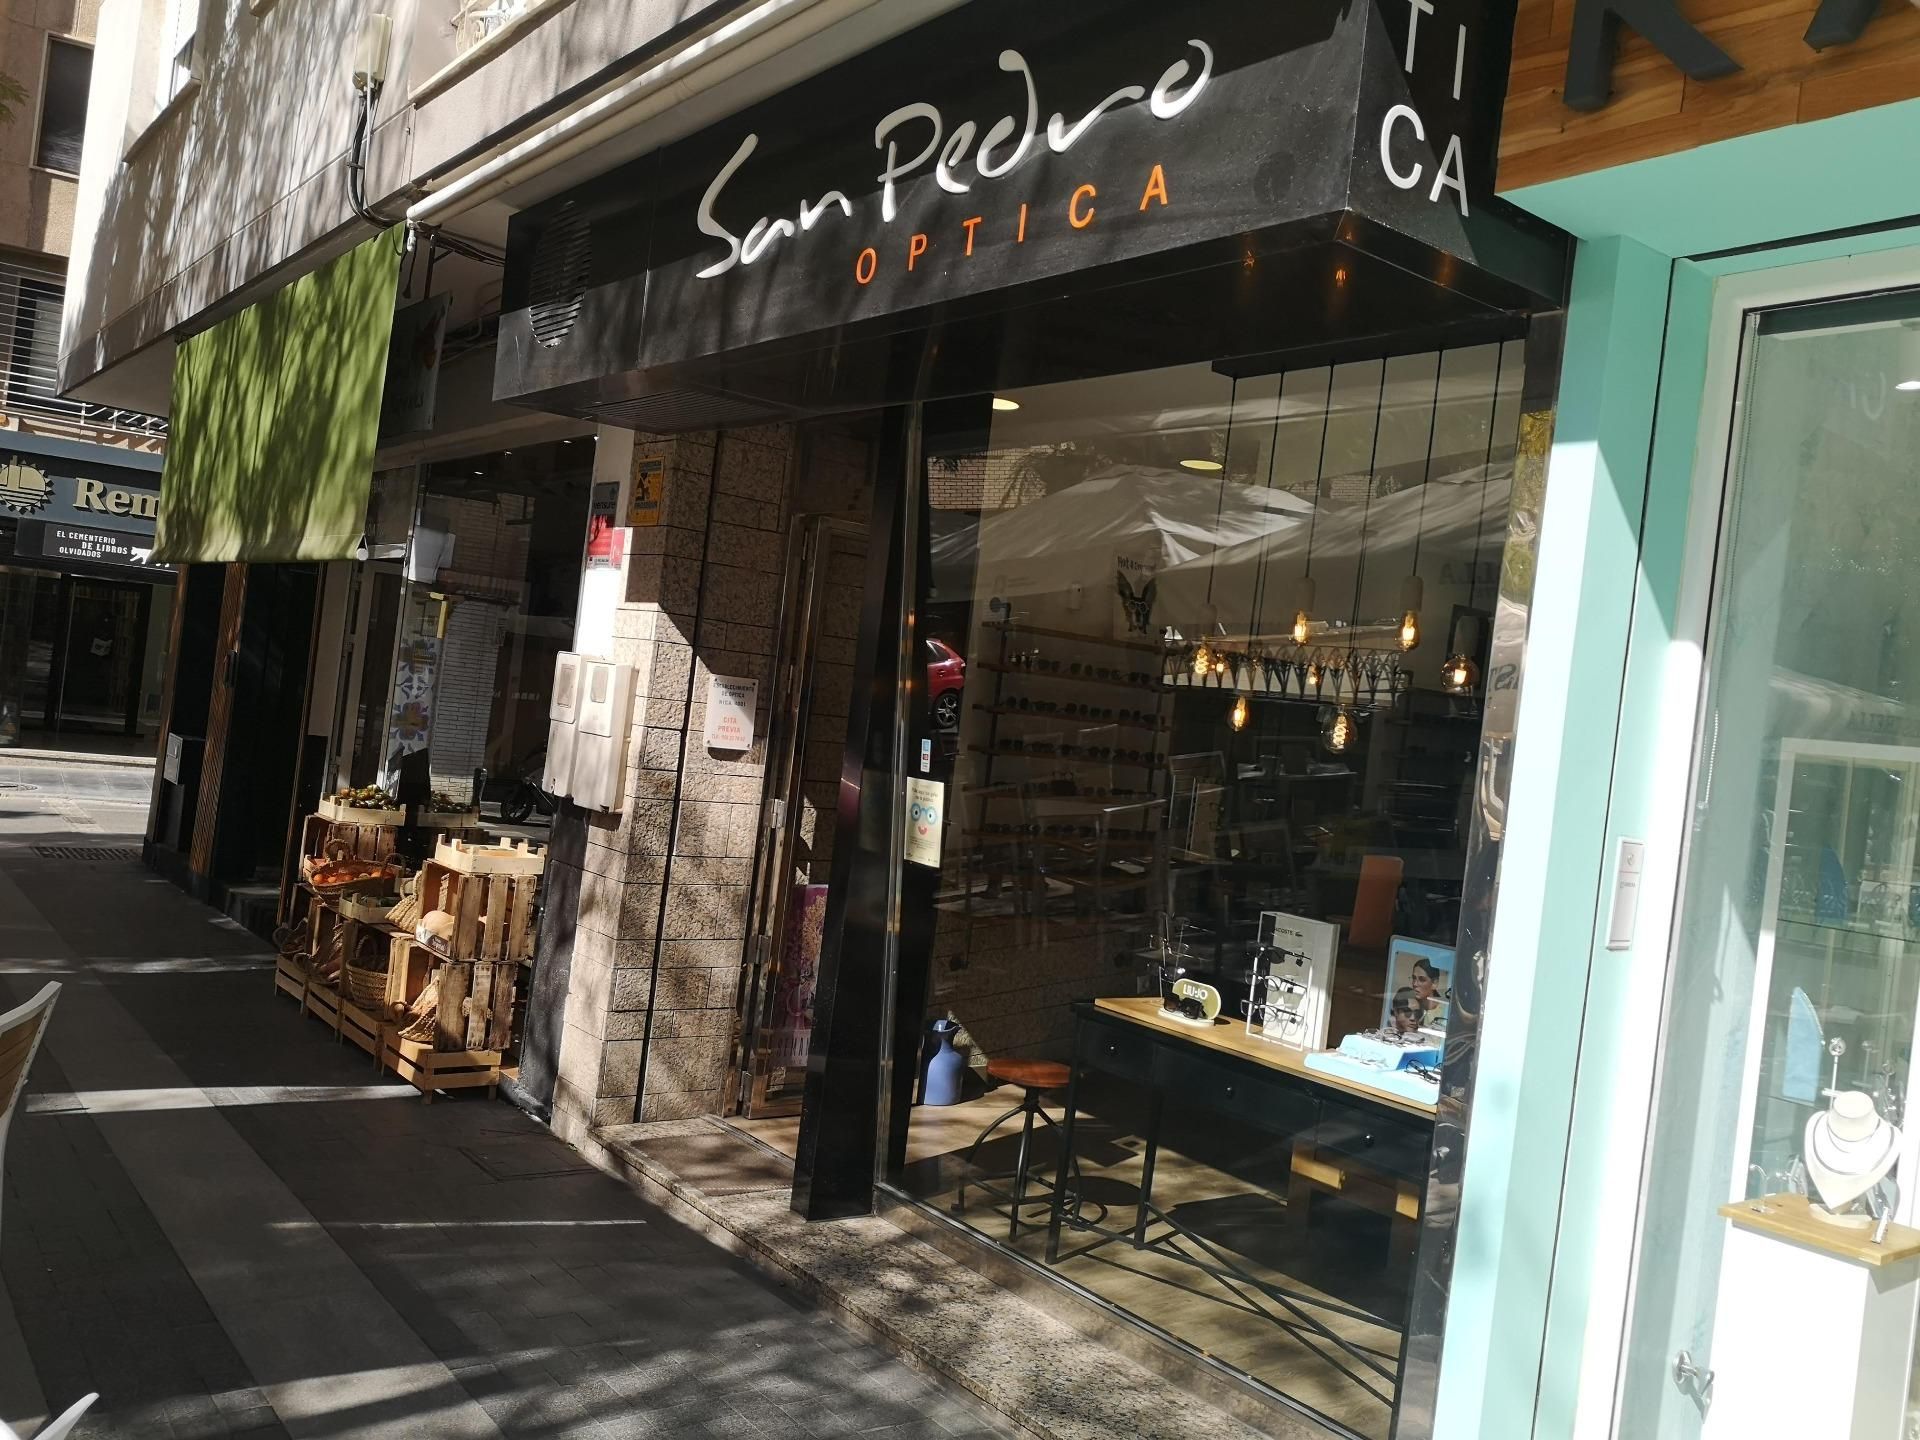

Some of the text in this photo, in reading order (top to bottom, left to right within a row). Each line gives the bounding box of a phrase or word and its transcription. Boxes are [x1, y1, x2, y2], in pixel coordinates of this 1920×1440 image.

[696, 38, 1214, 279] San Pedro
[855, 164, 1169, 284] OPTICA
[57, 530, 116, 545] EL CEMENTERIO
[59, 546, 101, 558] OLVIDADOS
[82, 541, 128, 555] DE LIBROS
[723, 716, 737, 724] CITA
[718, 725, 741, 733] PREVIA
